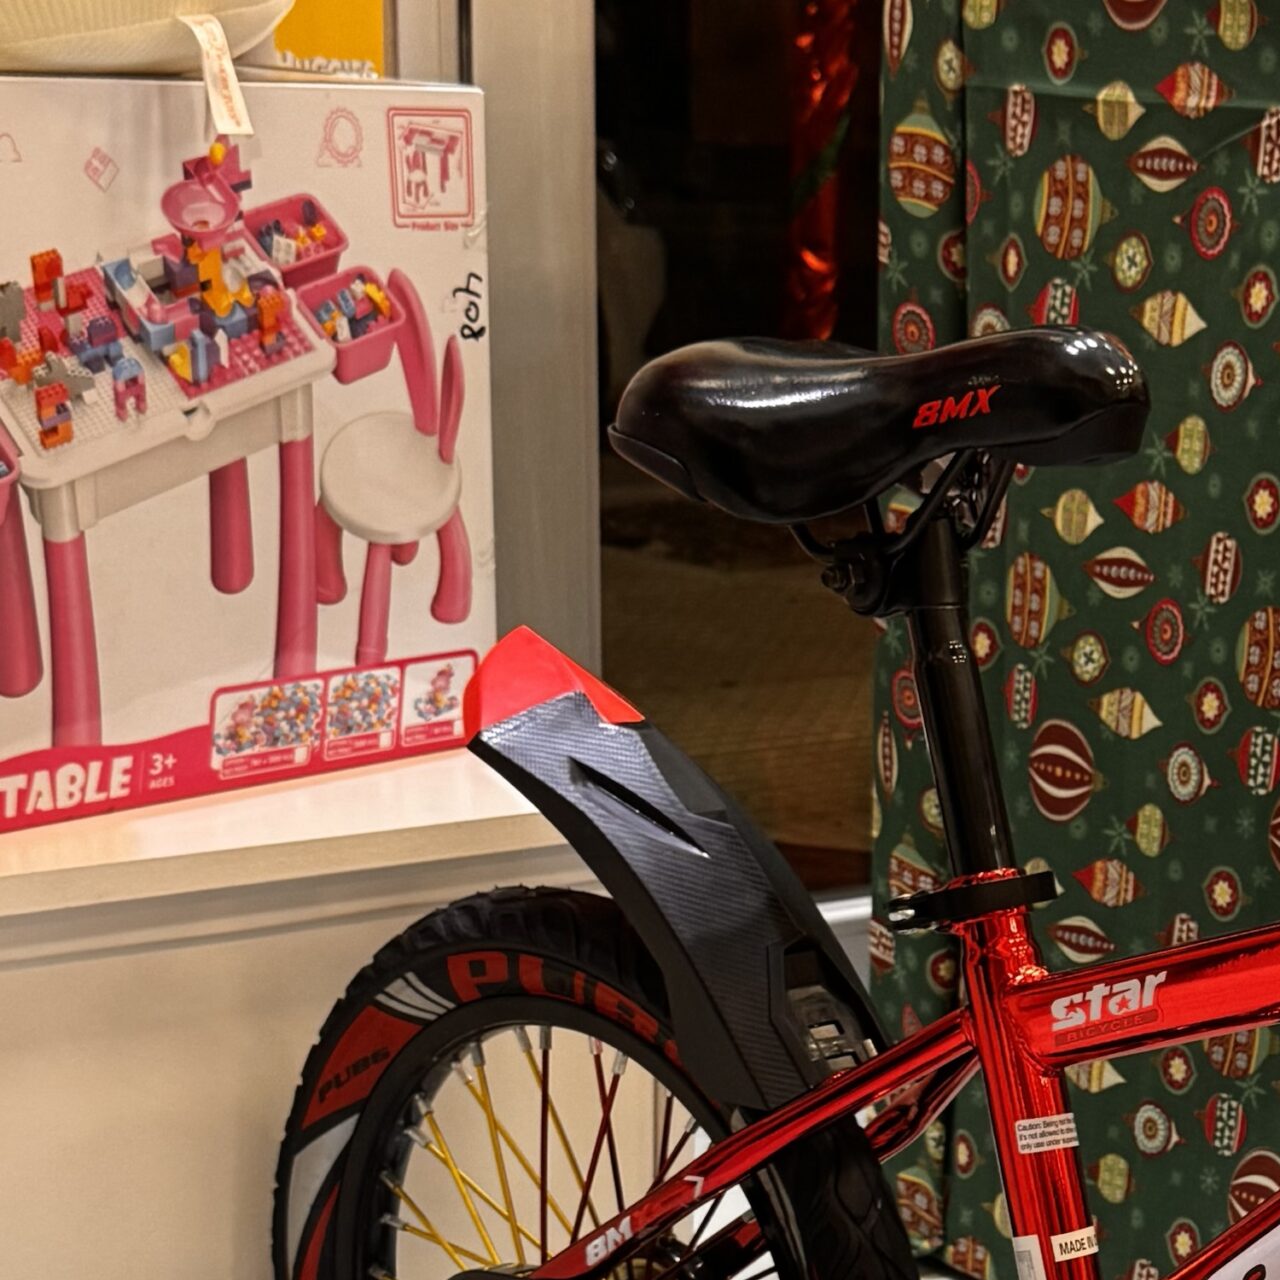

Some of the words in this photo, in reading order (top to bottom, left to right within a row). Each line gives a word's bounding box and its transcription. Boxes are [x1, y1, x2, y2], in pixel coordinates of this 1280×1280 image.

[149, 753, 177, 776] 3+
[0, 756, 134, 818] TABLE
[1067, 1015, 1144, 1041] BICYCLE
[318, 1046, 392, 1103] PUBG
[1059, 1238, 1087, 1256] MADE
